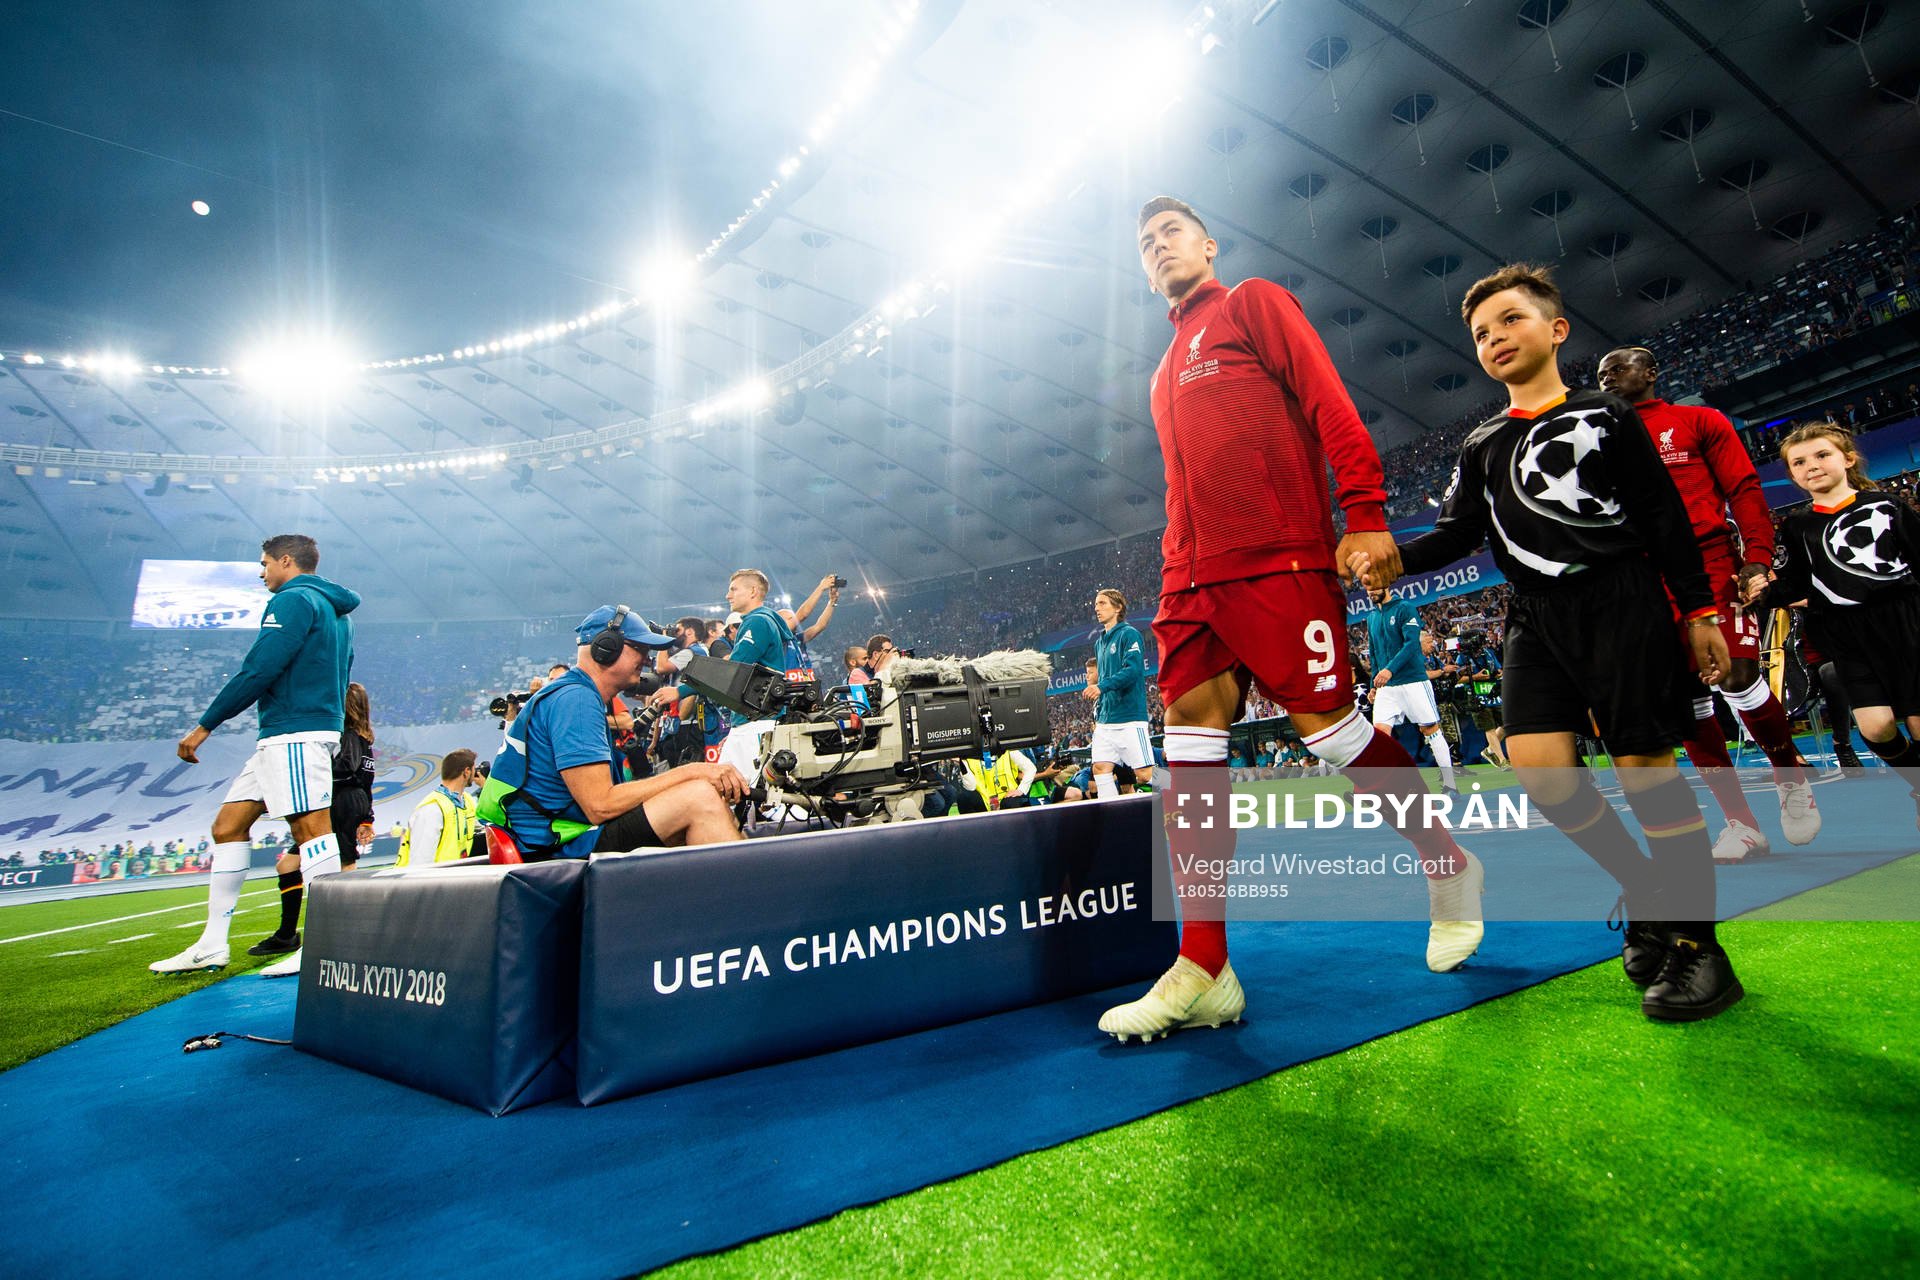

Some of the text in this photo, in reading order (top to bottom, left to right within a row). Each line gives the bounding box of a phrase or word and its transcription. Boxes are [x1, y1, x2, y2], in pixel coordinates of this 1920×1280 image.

[1433, 565, 1480, 593] 2018
[1303, 619, 1336, 674] 9
[927, 728, 961, 740] DIGISUPER
[962, 727, 971, 736] 95
[653, 881, 1138, 995] UEFA CHAMPIONS LEAGUE
[319, 958, 448, 1007] FINAL KYIV 2018
